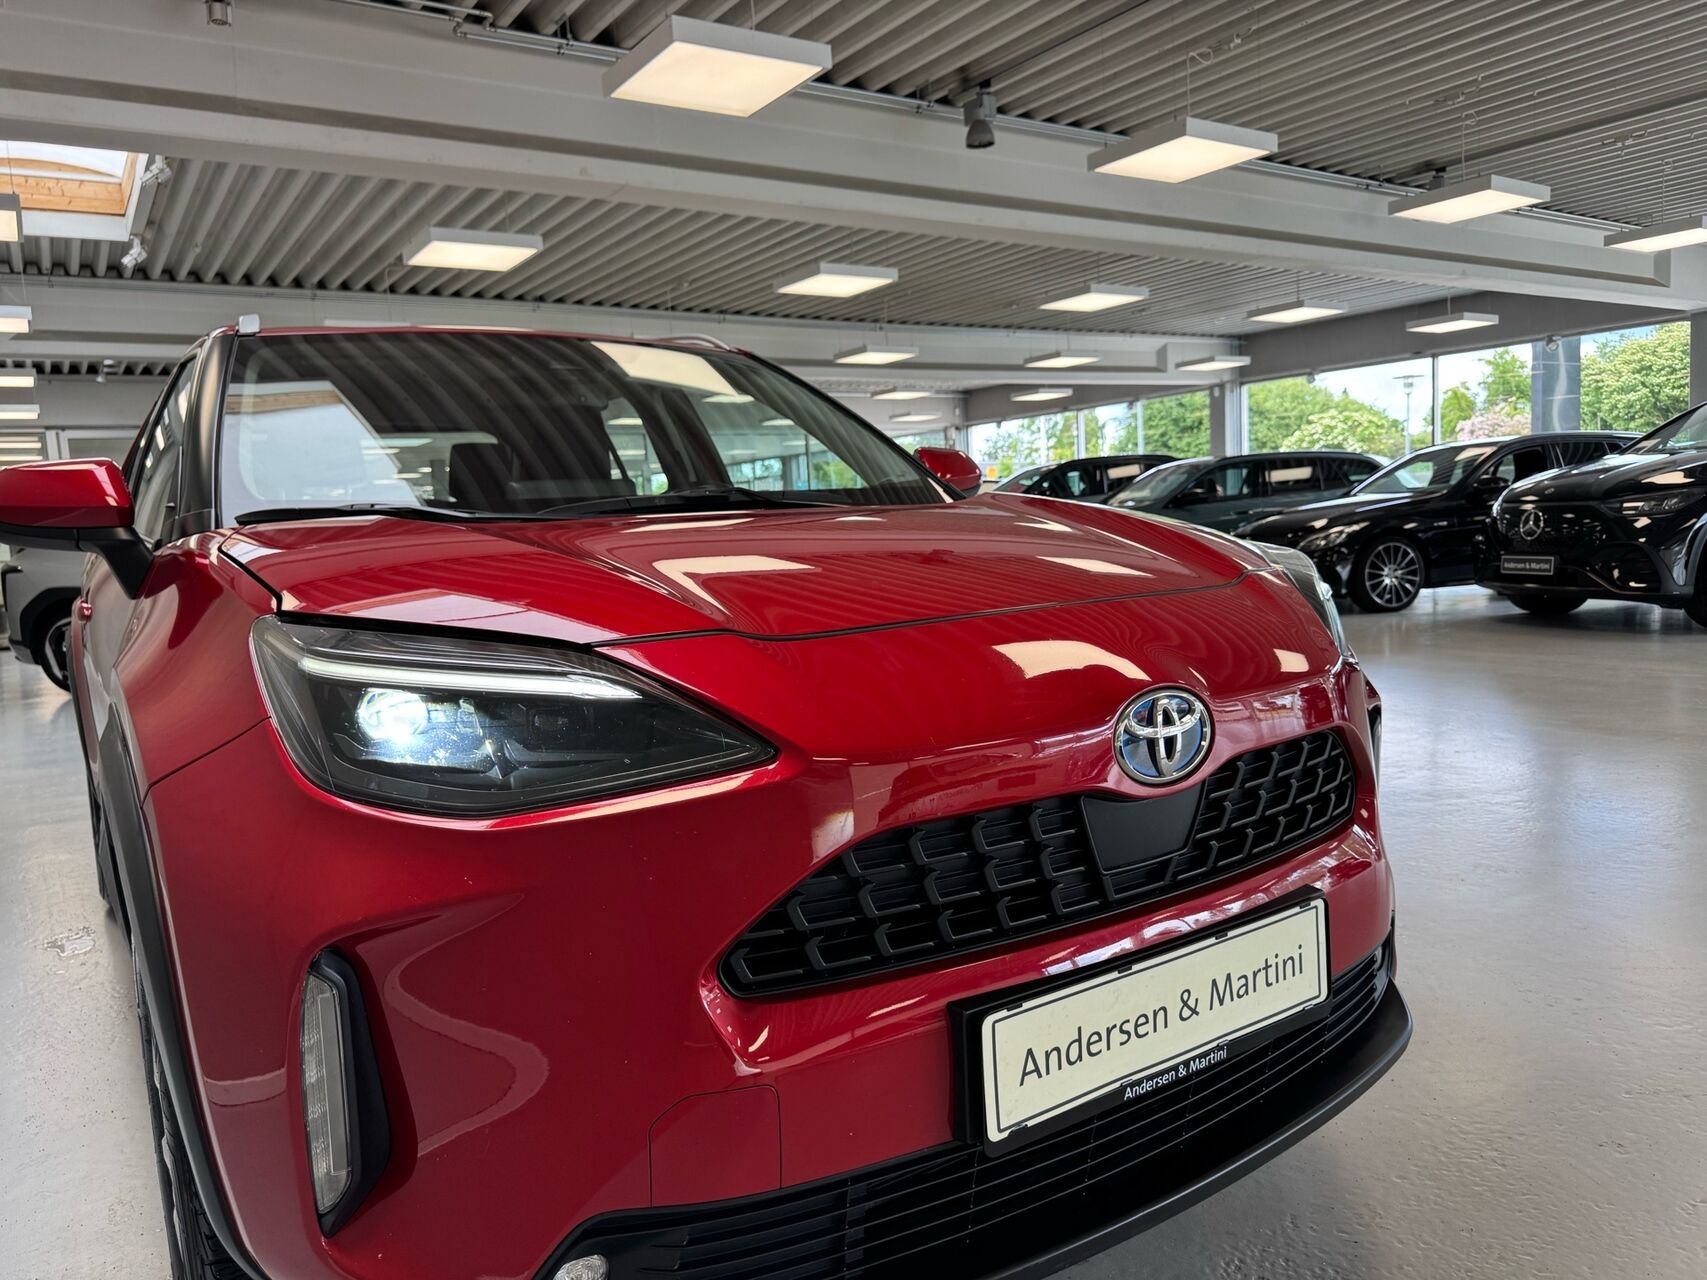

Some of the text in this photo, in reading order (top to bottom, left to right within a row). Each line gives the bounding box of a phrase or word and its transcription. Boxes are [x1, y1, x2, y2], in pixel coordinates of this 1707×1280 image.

[1019, 943, 1303, 1087] Andersen & Martini
[1123, 1046, 1228, 1101] Andersen & Martini
